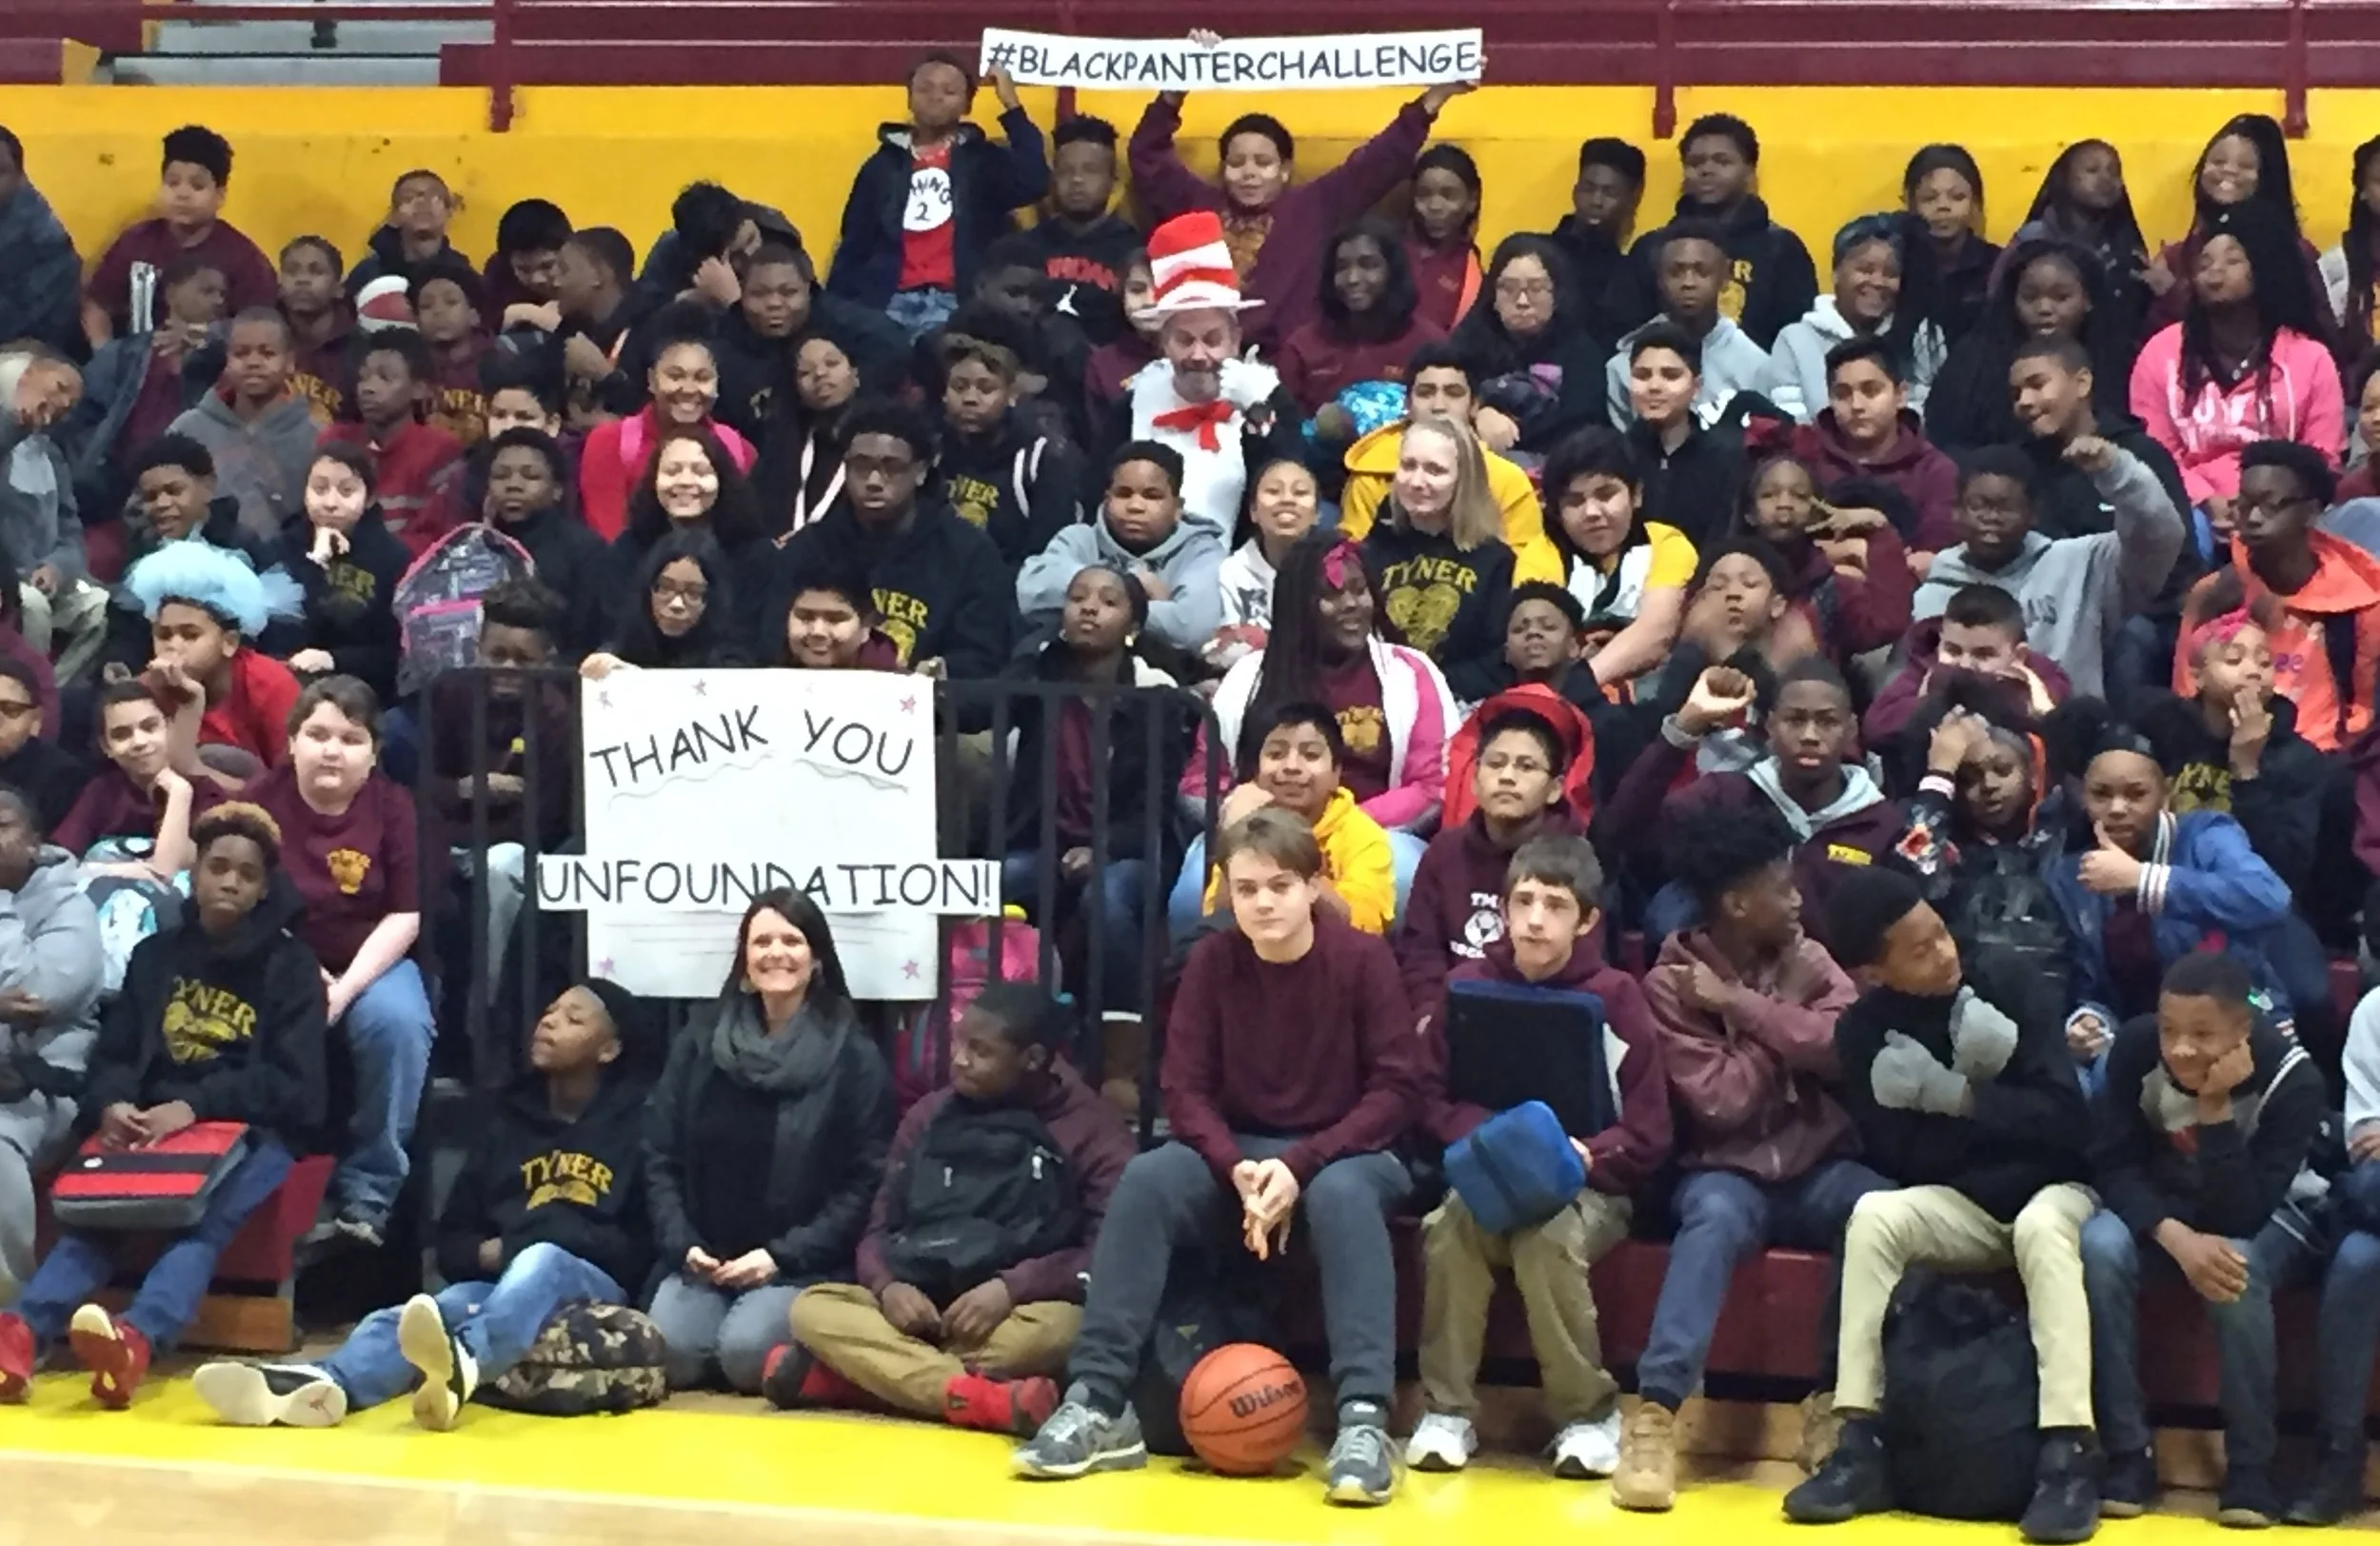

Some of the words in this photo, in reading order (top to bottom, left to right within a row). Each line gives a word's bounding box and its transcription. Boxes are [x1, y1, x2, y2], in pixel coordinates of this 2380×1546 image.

[986, 41, 1478, 84] #BLACKPANTERCHALLENGE
[911, 176, 953, 206] HING
[915, 201, 932, 222] 2
[1380, 553, 1478, 595] TYNER
[589, 704, 769, 788] THANK
[803, 708, 914, 777] YOU
[519, 1148, 615, 1196] TYNER
[1228, 1379, 1303, 1419] Wilson
